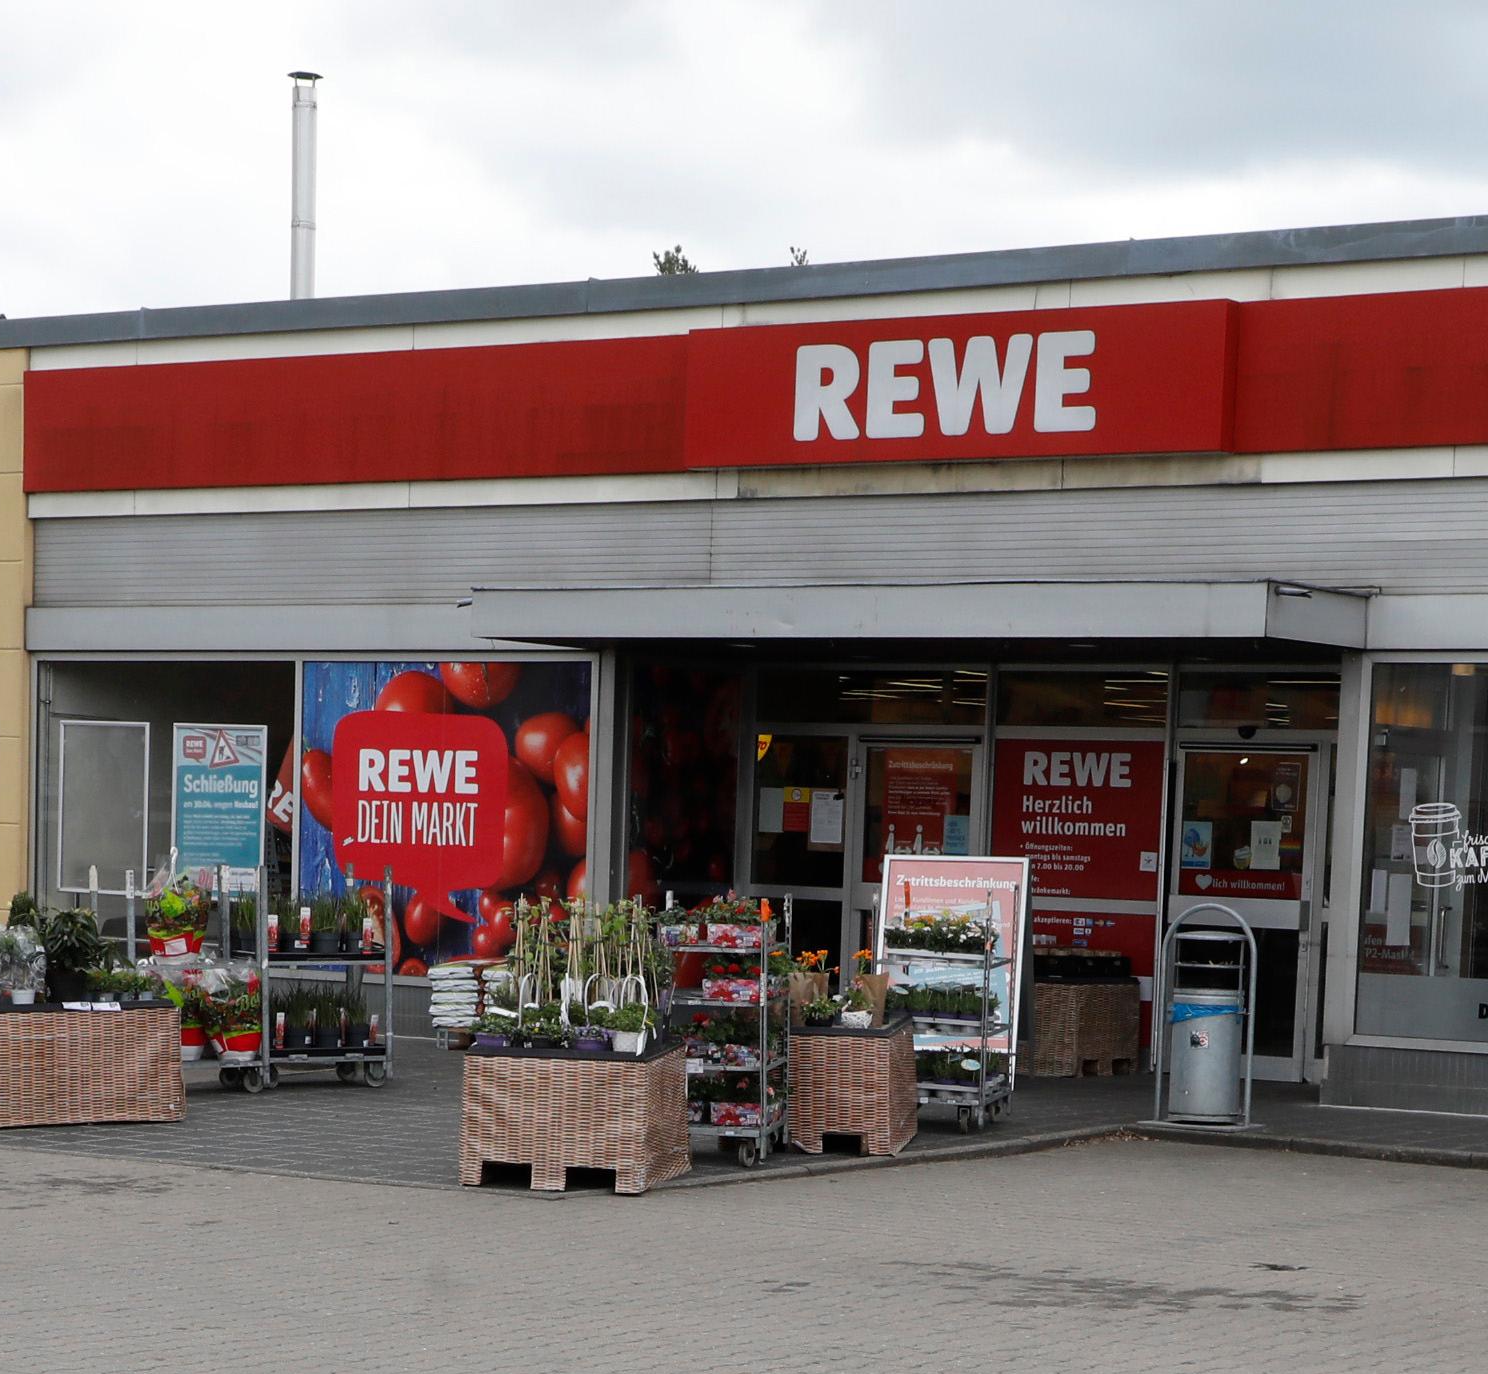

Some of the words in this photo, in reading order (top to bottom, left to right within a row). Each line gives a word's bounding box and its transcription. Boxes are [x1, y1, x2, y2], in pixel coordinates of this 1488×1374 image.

[793, 329, 1097, 442] REWE
[358, 748, 479, 794] REWE
[1023, 751, 1132, 788] REWE
[183, 773, 259, 799] Schließung
[1022, 795, 1093, 815] Herzlich
[357, 799, 403, 844] DEIN
[411, 801, 479, 847] MARKT
[1021, 816, 1126, 837] willkommen
[1051, 853, 1062, 862] bis
[1053, 863, 1063, 871] bis
[1230, 879, 1286, 892] willkommen!
[1455, 871, 1476, 892] zum
